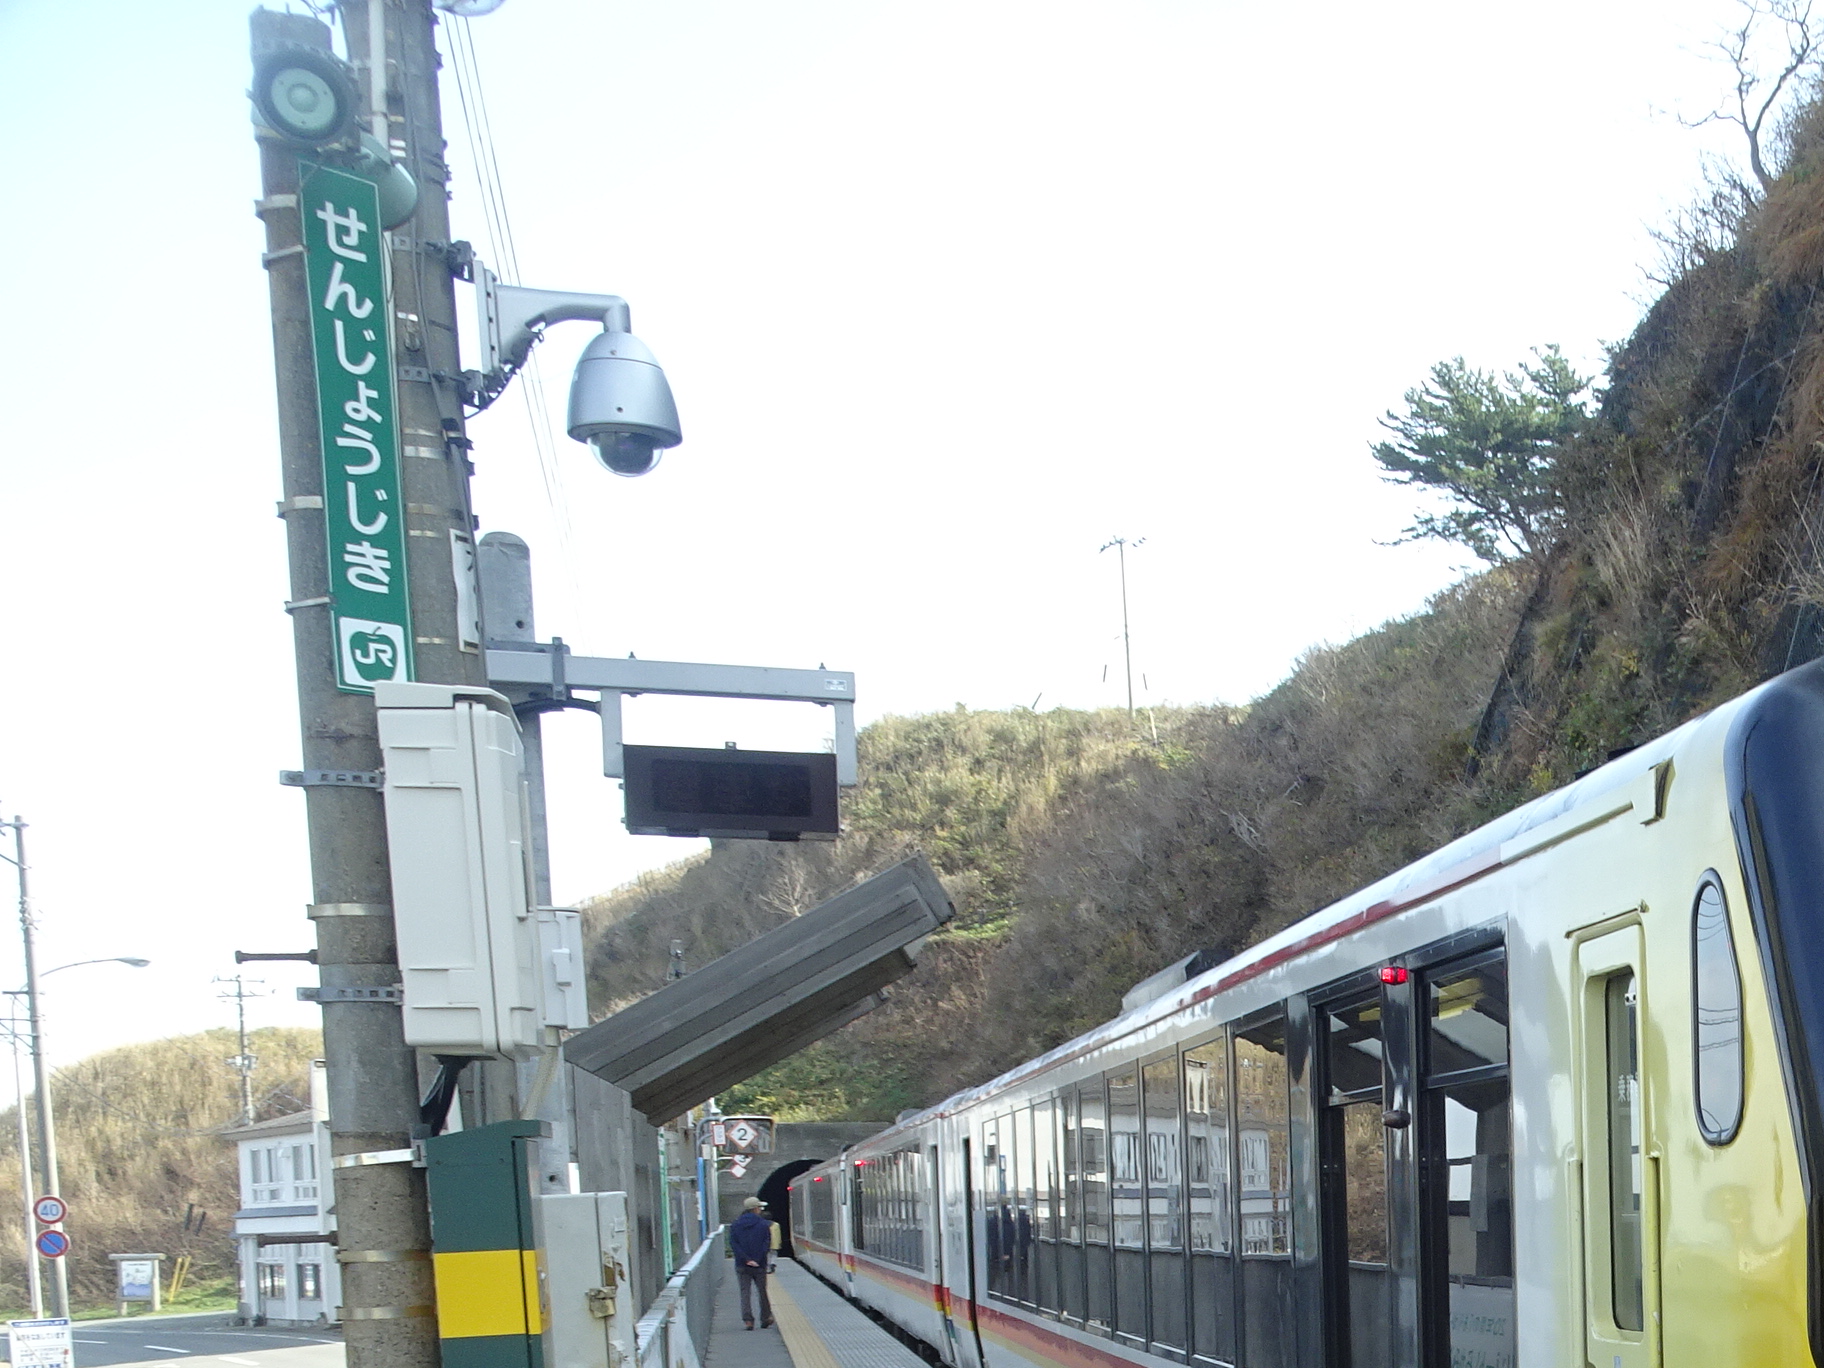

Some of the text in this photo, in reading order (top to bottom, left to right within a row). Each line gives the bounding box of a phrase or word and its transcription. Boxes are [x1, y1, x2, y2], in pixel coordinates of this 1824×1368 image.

[316, 200, 392, 595] せんじょうじき
[354, 642, 394, 668] JR
[737, 1127, 748, 1141] 2
[40, 1203, 60, 1217] 40
